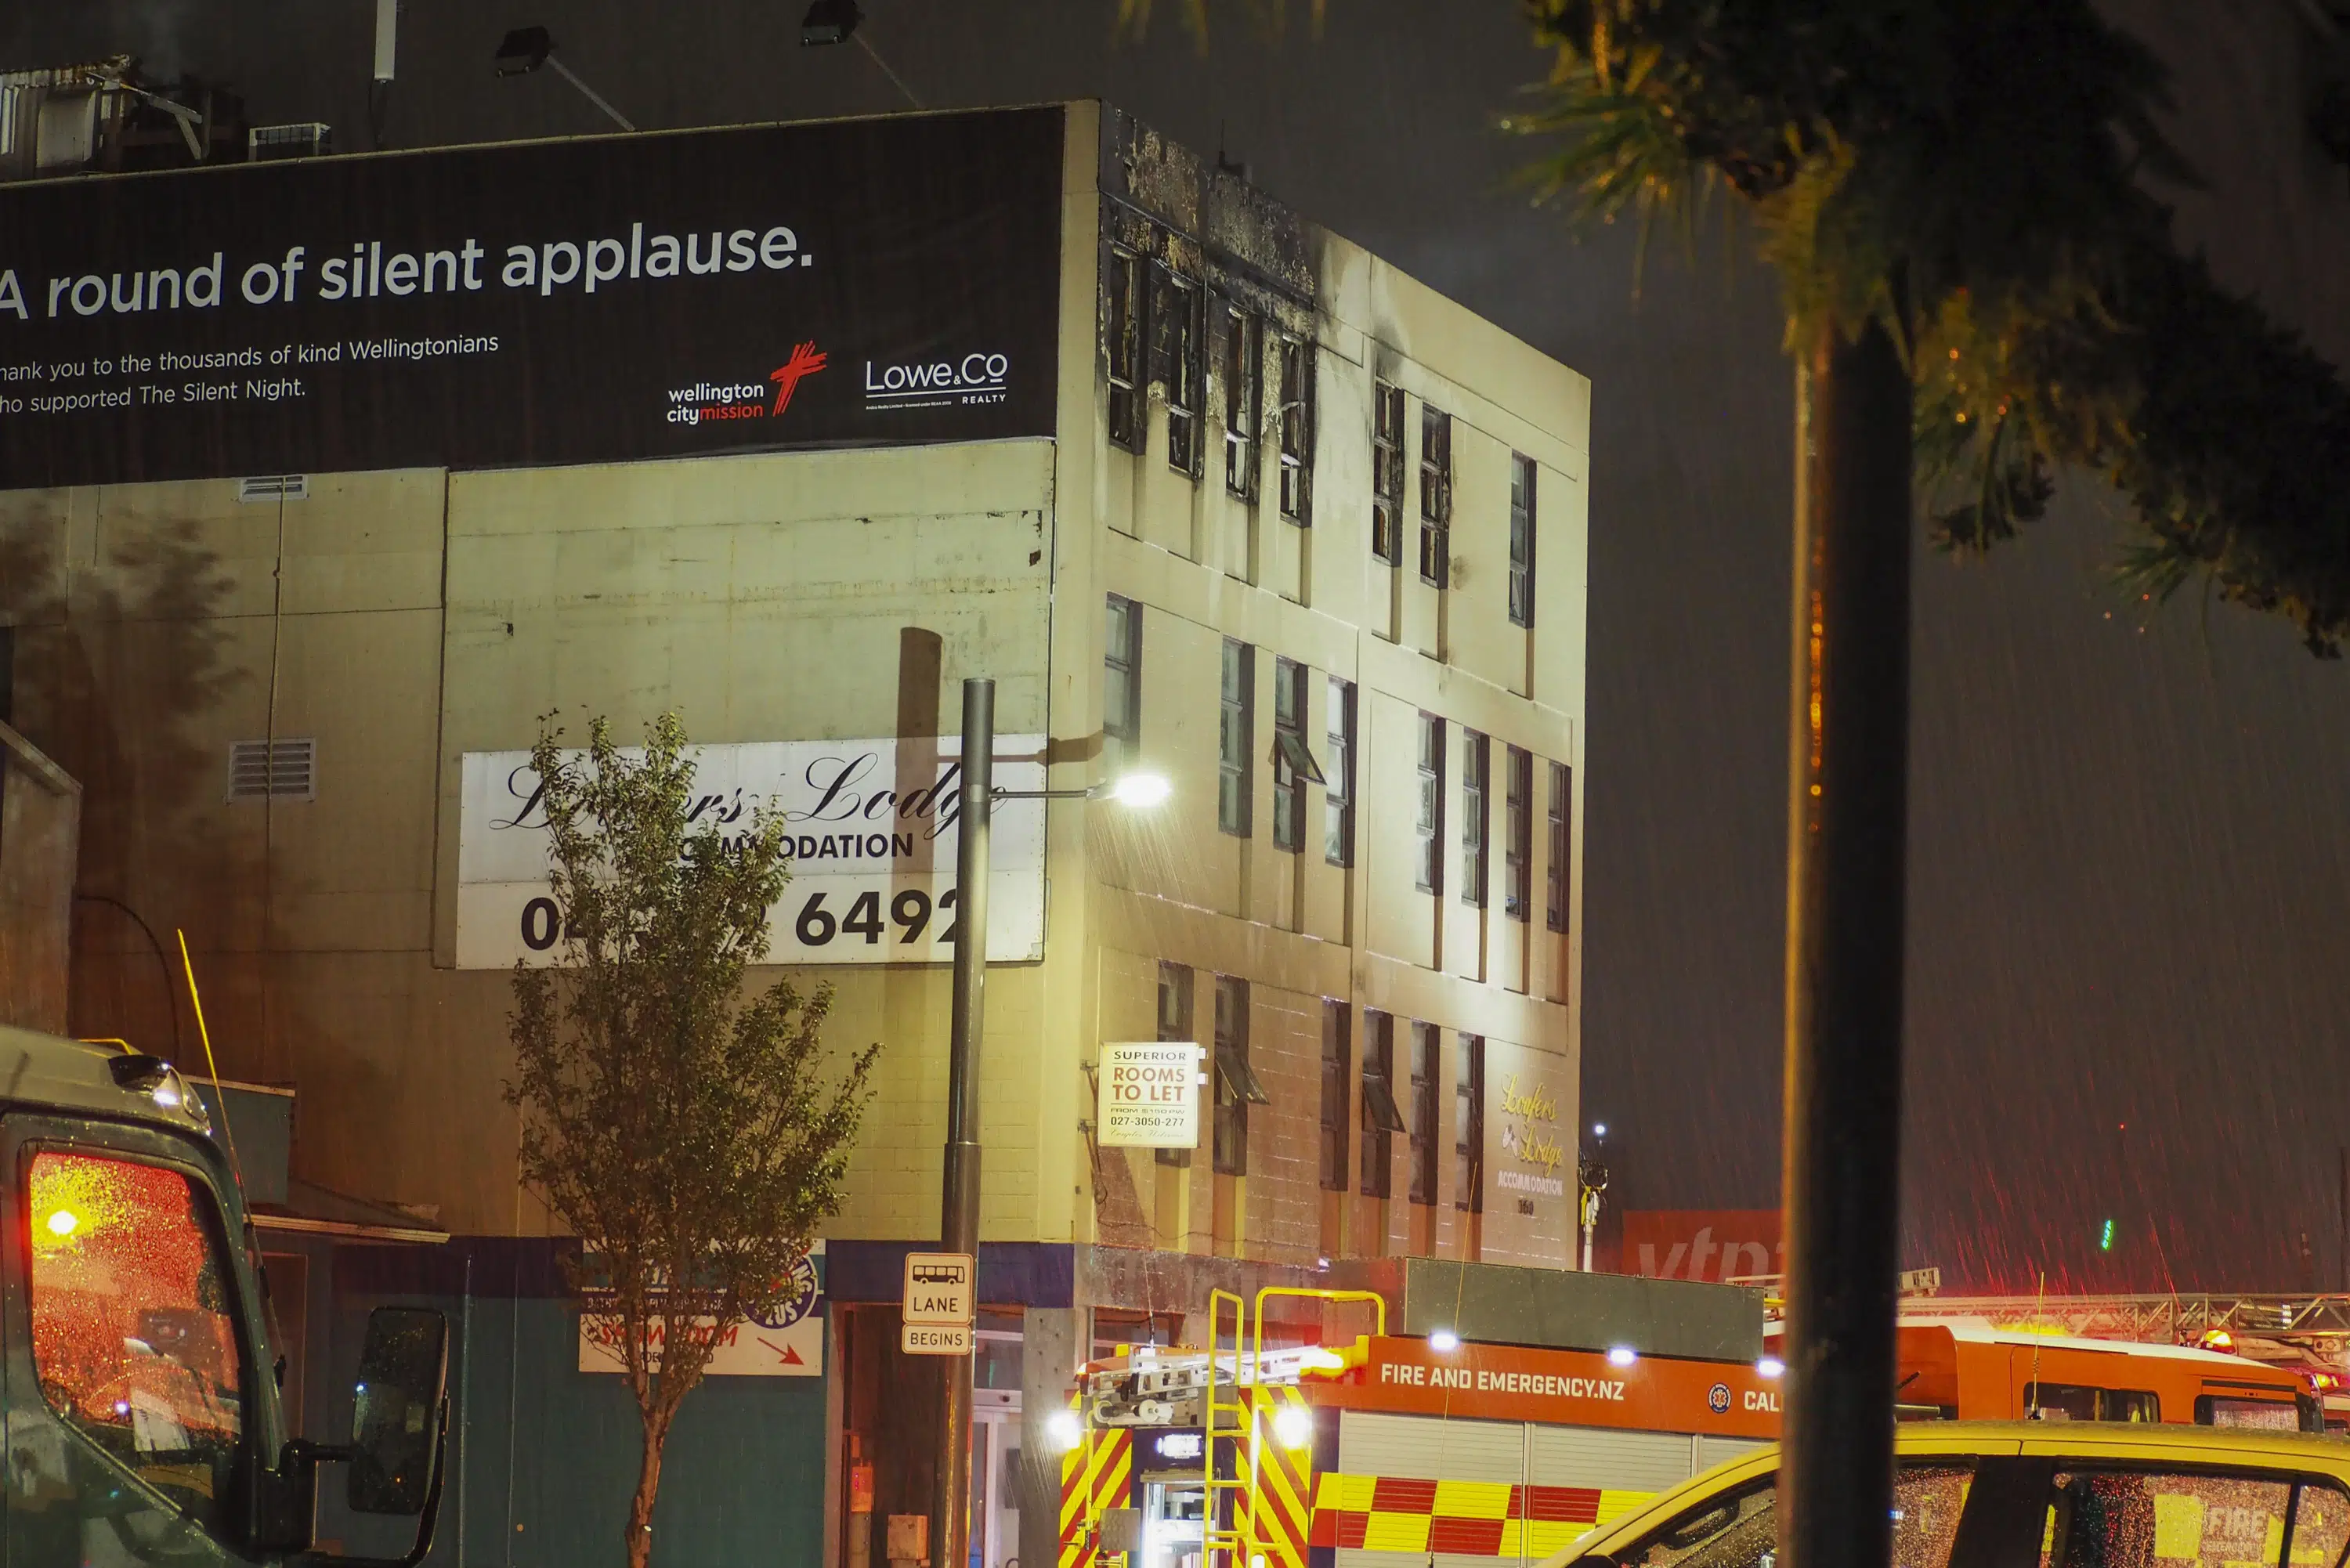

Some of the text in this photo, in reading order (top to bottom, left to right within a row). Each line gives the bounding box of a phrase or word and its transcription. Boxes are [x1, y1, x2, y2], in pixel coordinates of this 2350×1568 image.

[0, 222, 812, 320] A round of silent applause.
[49, 362, 85, 382] you
[93, 357, 113, 375] to
[120, 354, 152, 374] the
[159, 346, 262, 370] thousands
[269, 345, 291, 365] of
[298, 341, 341, 363] kind
[349, 334, 499, 361] Wellingtonians
[0, 378, 306, 414] ho supported The Silent Night.
[668, 382, 764, 404] wellington
[962, 394, 1006, 405] REALTY
[667, 400, 764, 425] citymission
[1114, 1050, 1186, 1060] SUPERIOR
[1113, 1067, 1185, 1082] ROOMS
[1112, 1084, 1185, 1102] TO LET
[1110, 1116, 1184, 1127] 027-3050-277
[1519, 1122, 1564, 1178] Lodge
[1498, 1169, 1564, 1196] ACCOMMODATION
[913, 1297, 958, 1313] LANE
[910, 1332, 963, 1346] BEGINS
[1381, 1364, 1426, 1386] FIRE
[1430, 1369, 1473, 1390] AND
[1477, 1371, 1625, 1401] EMERGENCY.NZ
[1744, 1390, 1782, 1413] CAL
[2207, 1508, 2266, 1537] FIRE
